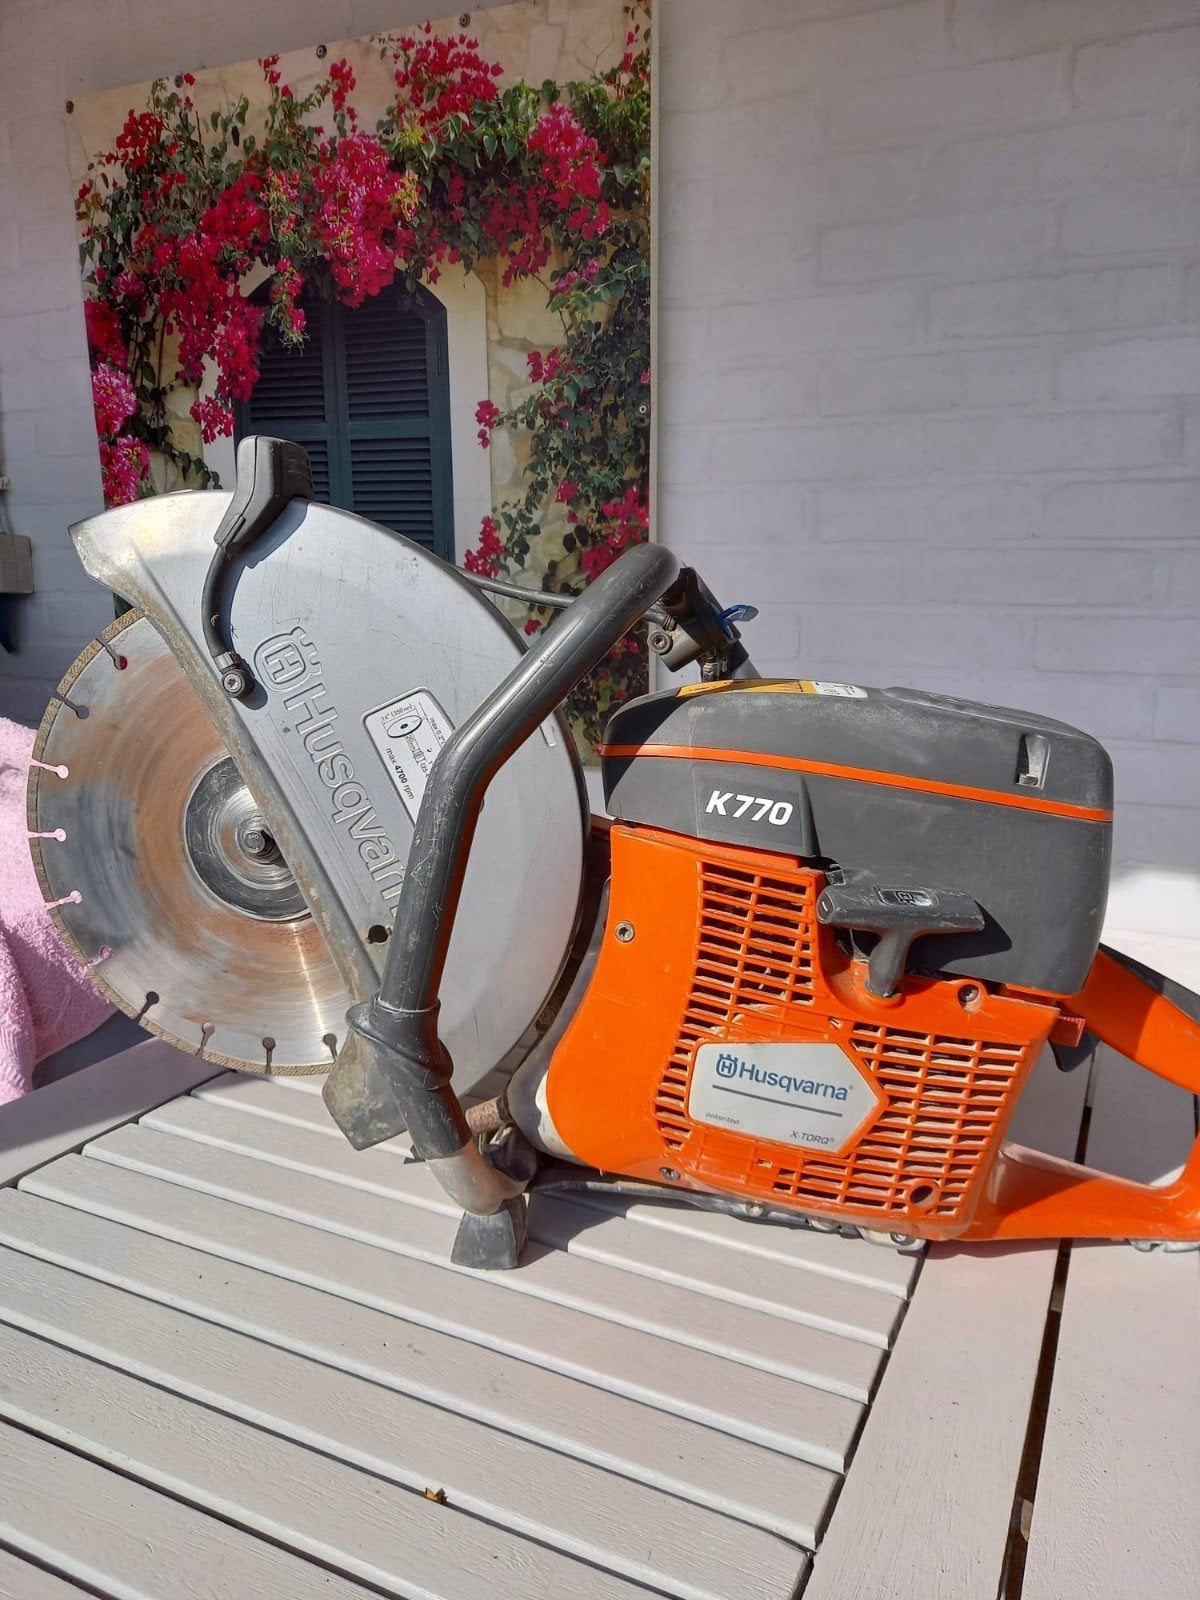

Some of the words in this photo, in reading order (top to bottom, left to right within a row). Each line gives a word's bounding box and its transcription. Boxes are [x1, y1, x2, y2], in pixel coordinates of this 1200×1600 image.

[385, 748, 397, 764] max
[394, 764, 408, 784] 4700
[403, 784, 415, 800] rpm
[284, 682, 405, 917] Husqvar
[705, 790, 793, 825] K770
[705, 1112, 740, 1125] patented
